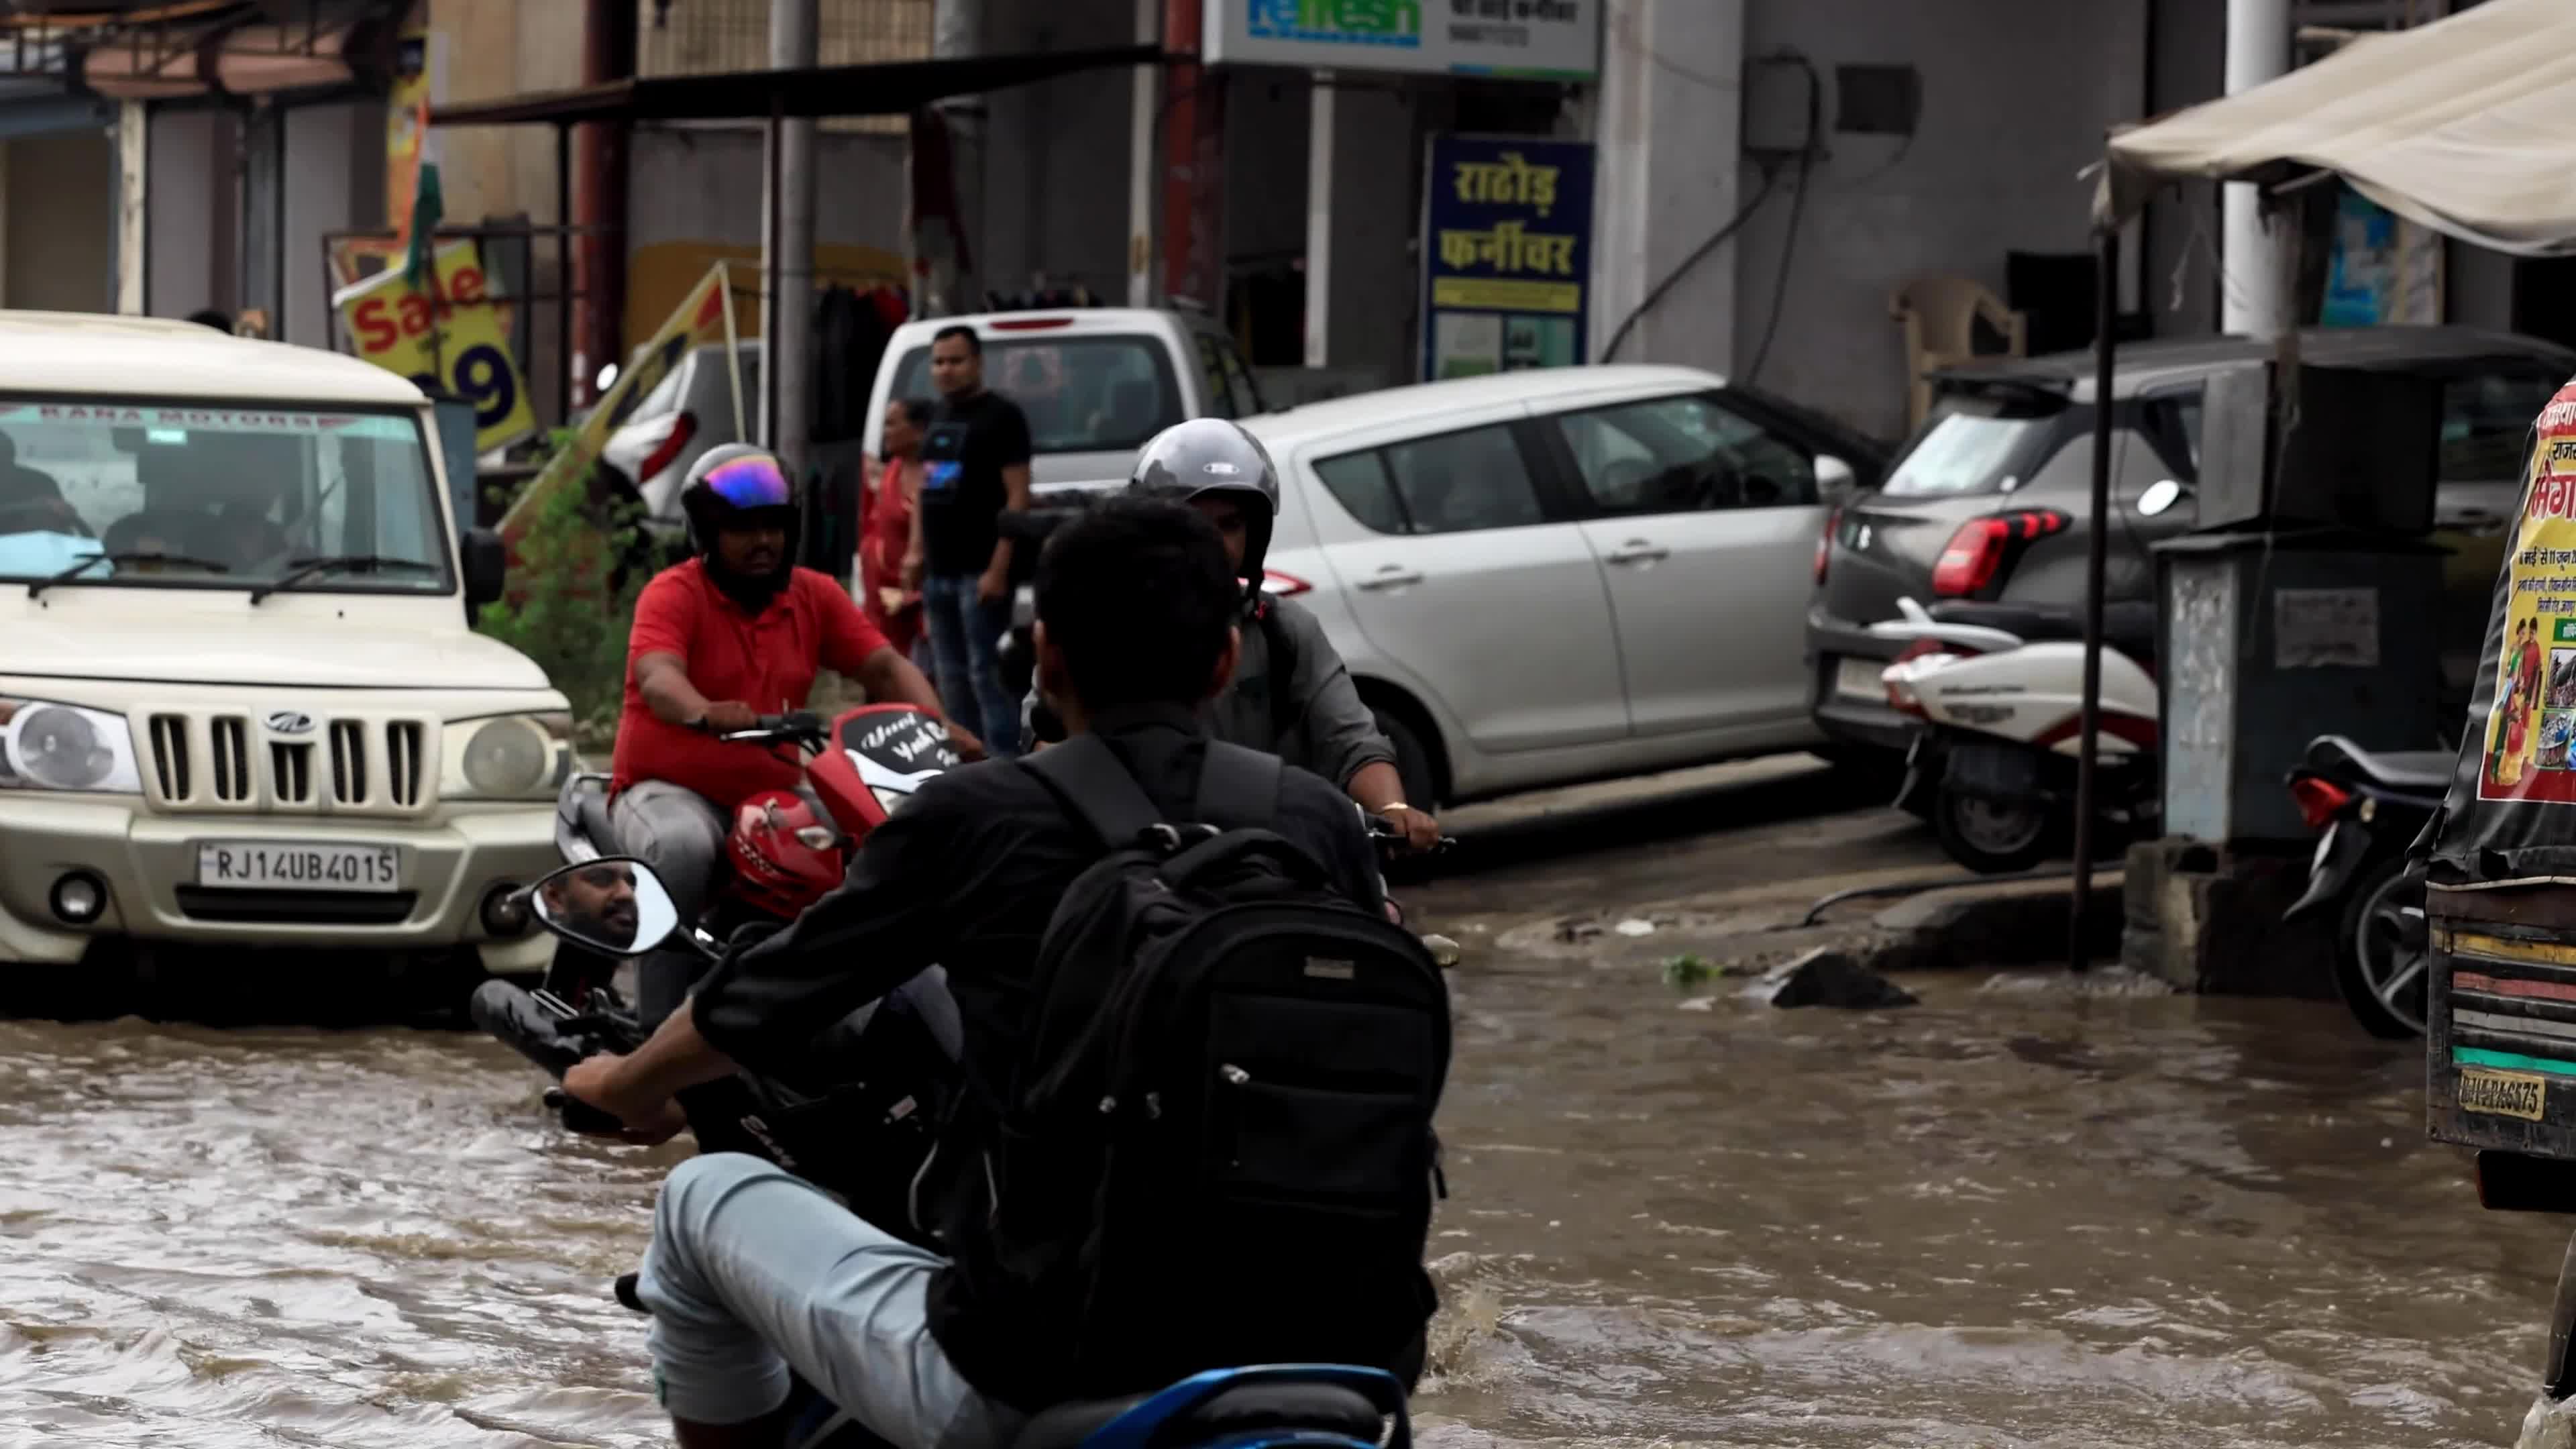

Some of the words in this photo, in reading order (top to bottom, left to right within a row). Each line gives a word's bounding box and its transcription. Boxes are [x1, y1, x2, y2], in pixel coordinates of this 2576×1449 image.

[354, 266, 484, 354] Sale
[2540, 547, 2548, 565] से
[2557, 550, 2571, 571] जून
[218, 851, 393, 883] RJ14UB4015
